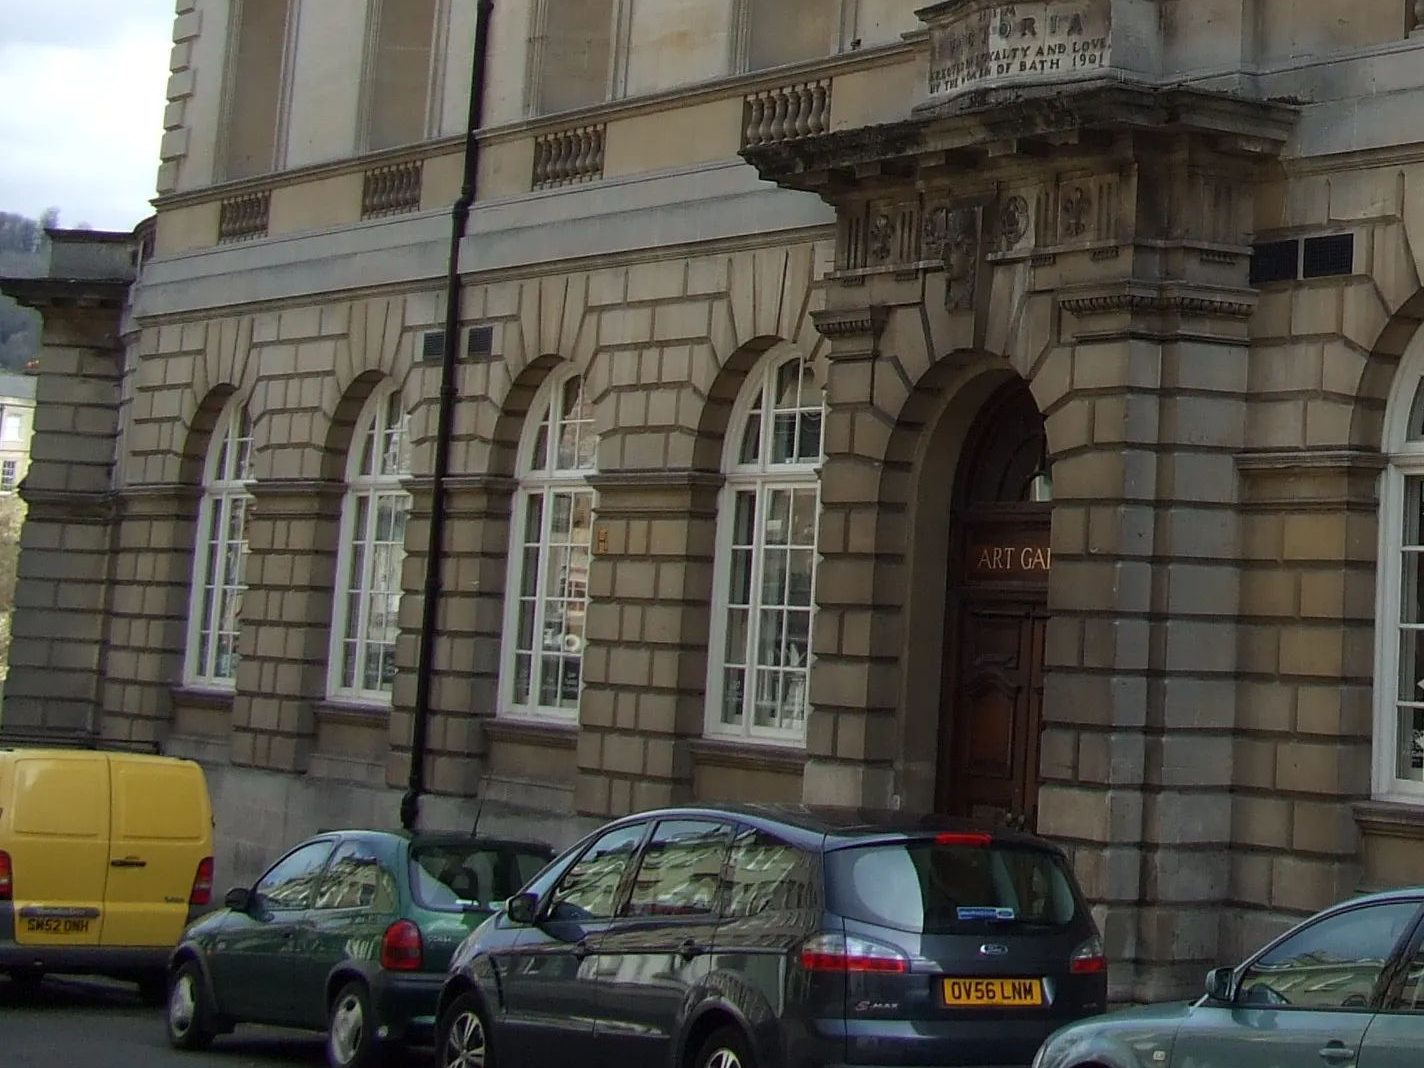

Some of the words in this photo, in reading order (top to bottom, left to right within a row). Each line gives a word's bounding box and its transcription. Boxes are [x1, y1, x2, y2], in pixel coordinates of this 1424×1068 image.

[1035, 43, 1067, 57] AND
[997, 62, 1012, 75] OF
[1019, 58, 1061, 72] BATH
[1072, 51, 1104, 68] 1901
[977, 547, 1016, 570] ART
[951, 981, 996, 1000] OV56
[1001, 981, 1033, 999] LNM
